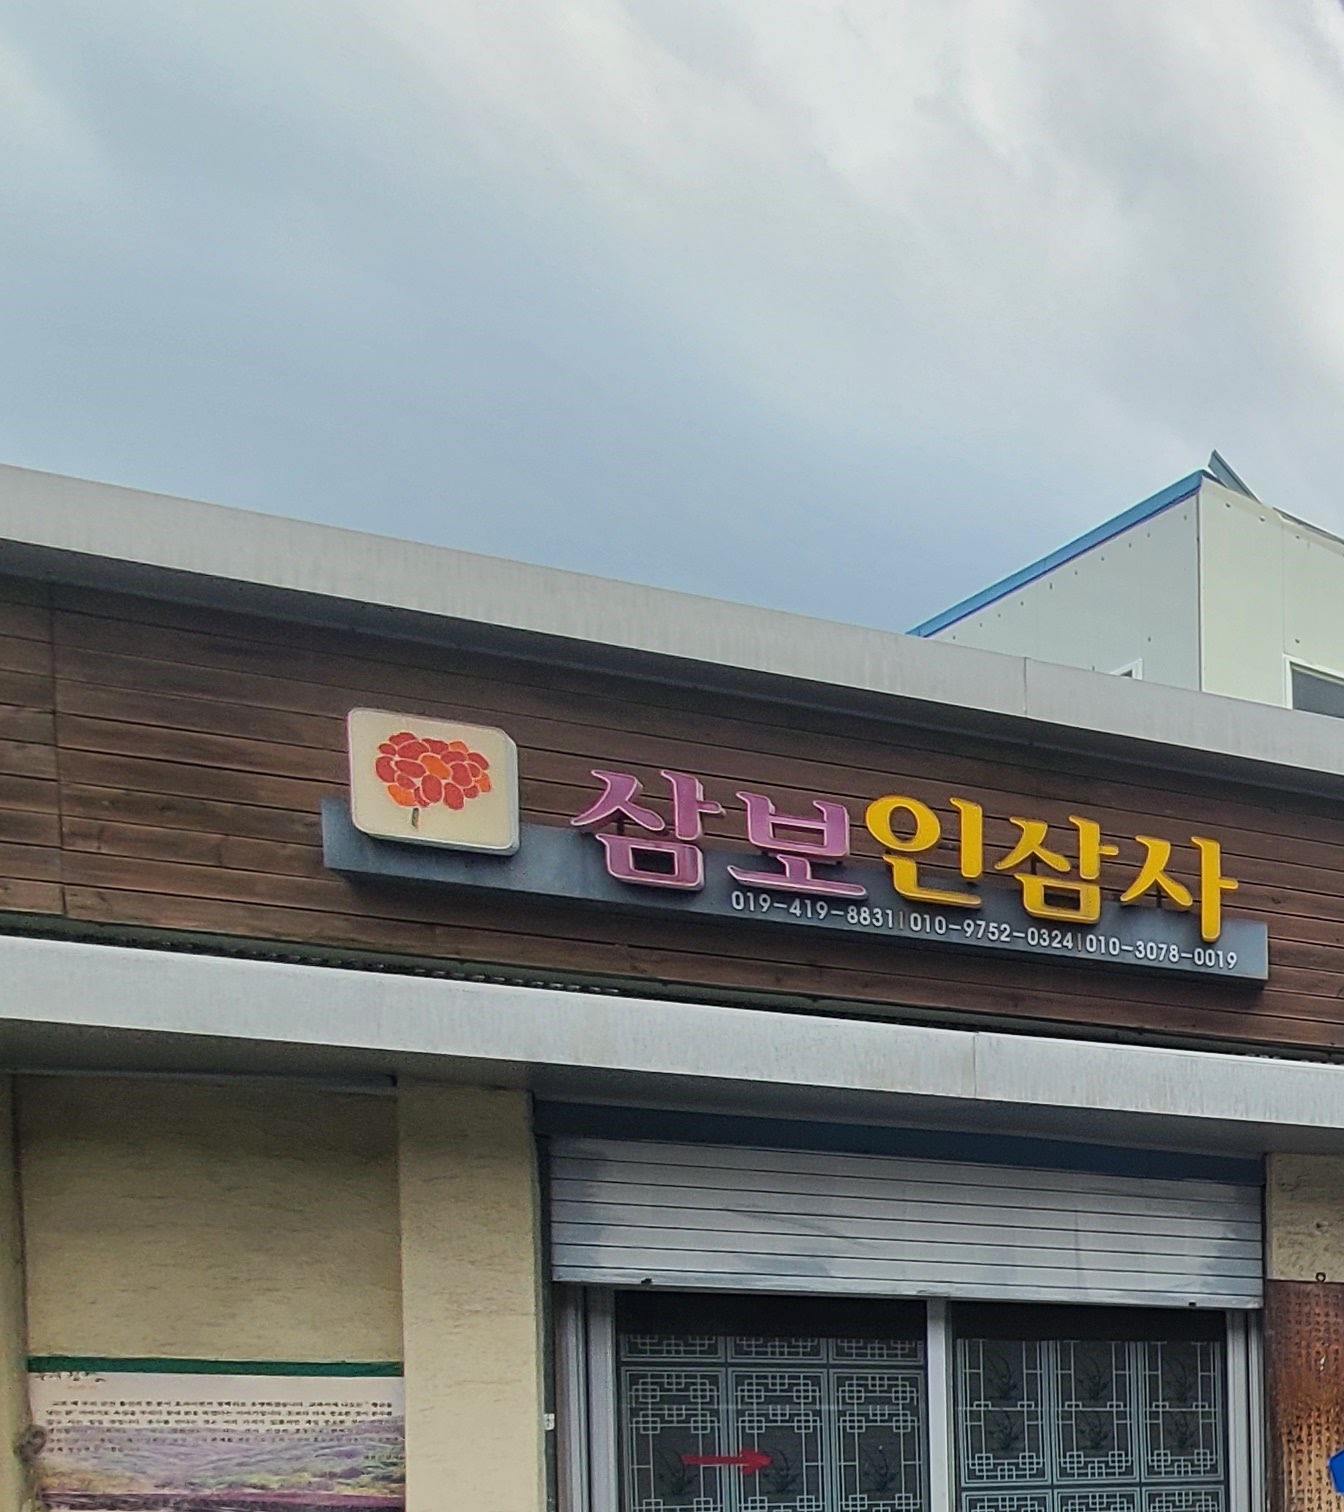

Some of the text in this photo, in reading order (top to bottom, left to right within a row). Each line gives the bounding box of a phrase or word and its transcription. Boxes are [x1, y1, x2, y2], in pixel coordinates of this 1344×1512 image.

[731, 890, 1238, 970] 019-419-8831 010-9752-0324 010-3078-0019
